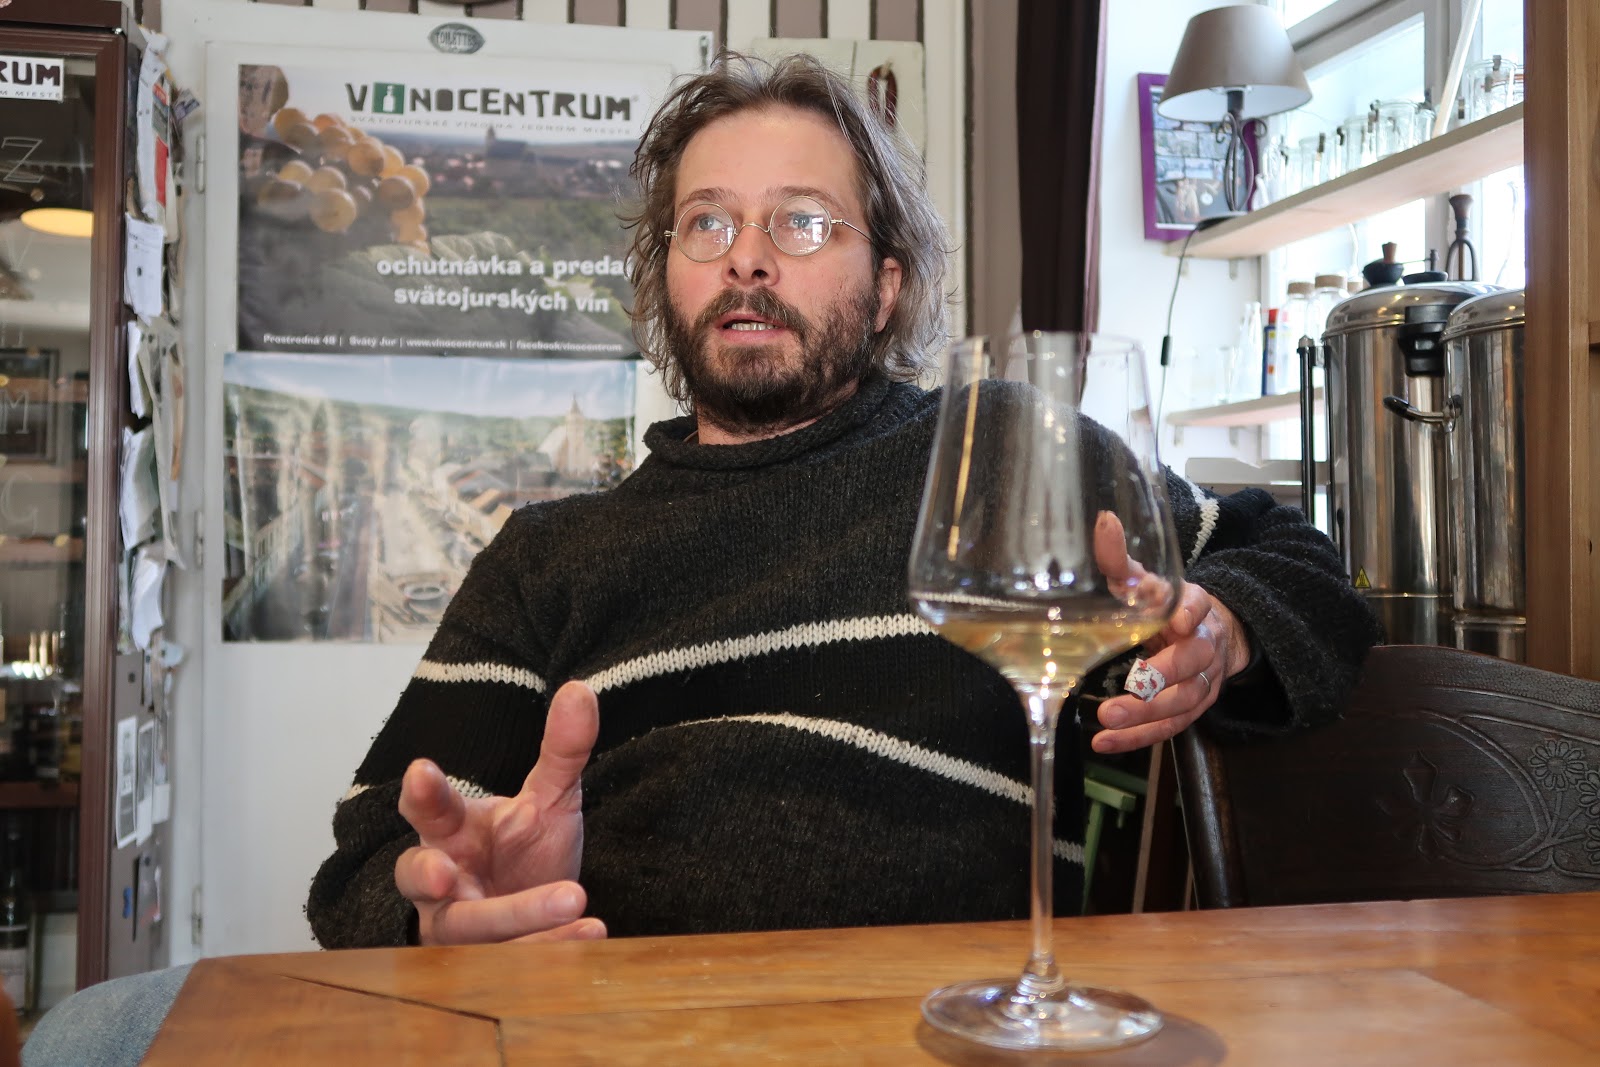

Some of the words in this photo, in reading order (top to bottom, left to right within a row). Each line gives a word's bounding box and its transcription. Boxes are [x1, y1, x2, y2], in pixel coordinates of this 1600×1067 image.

[15, 90, 60, 98] MIESTE
[376, 254, 522, 276] ochutnávka
[529, 259, 545, 276] a
[394, 285, 568, 315] svätojurských
[575, 292, 610, 313] vín
